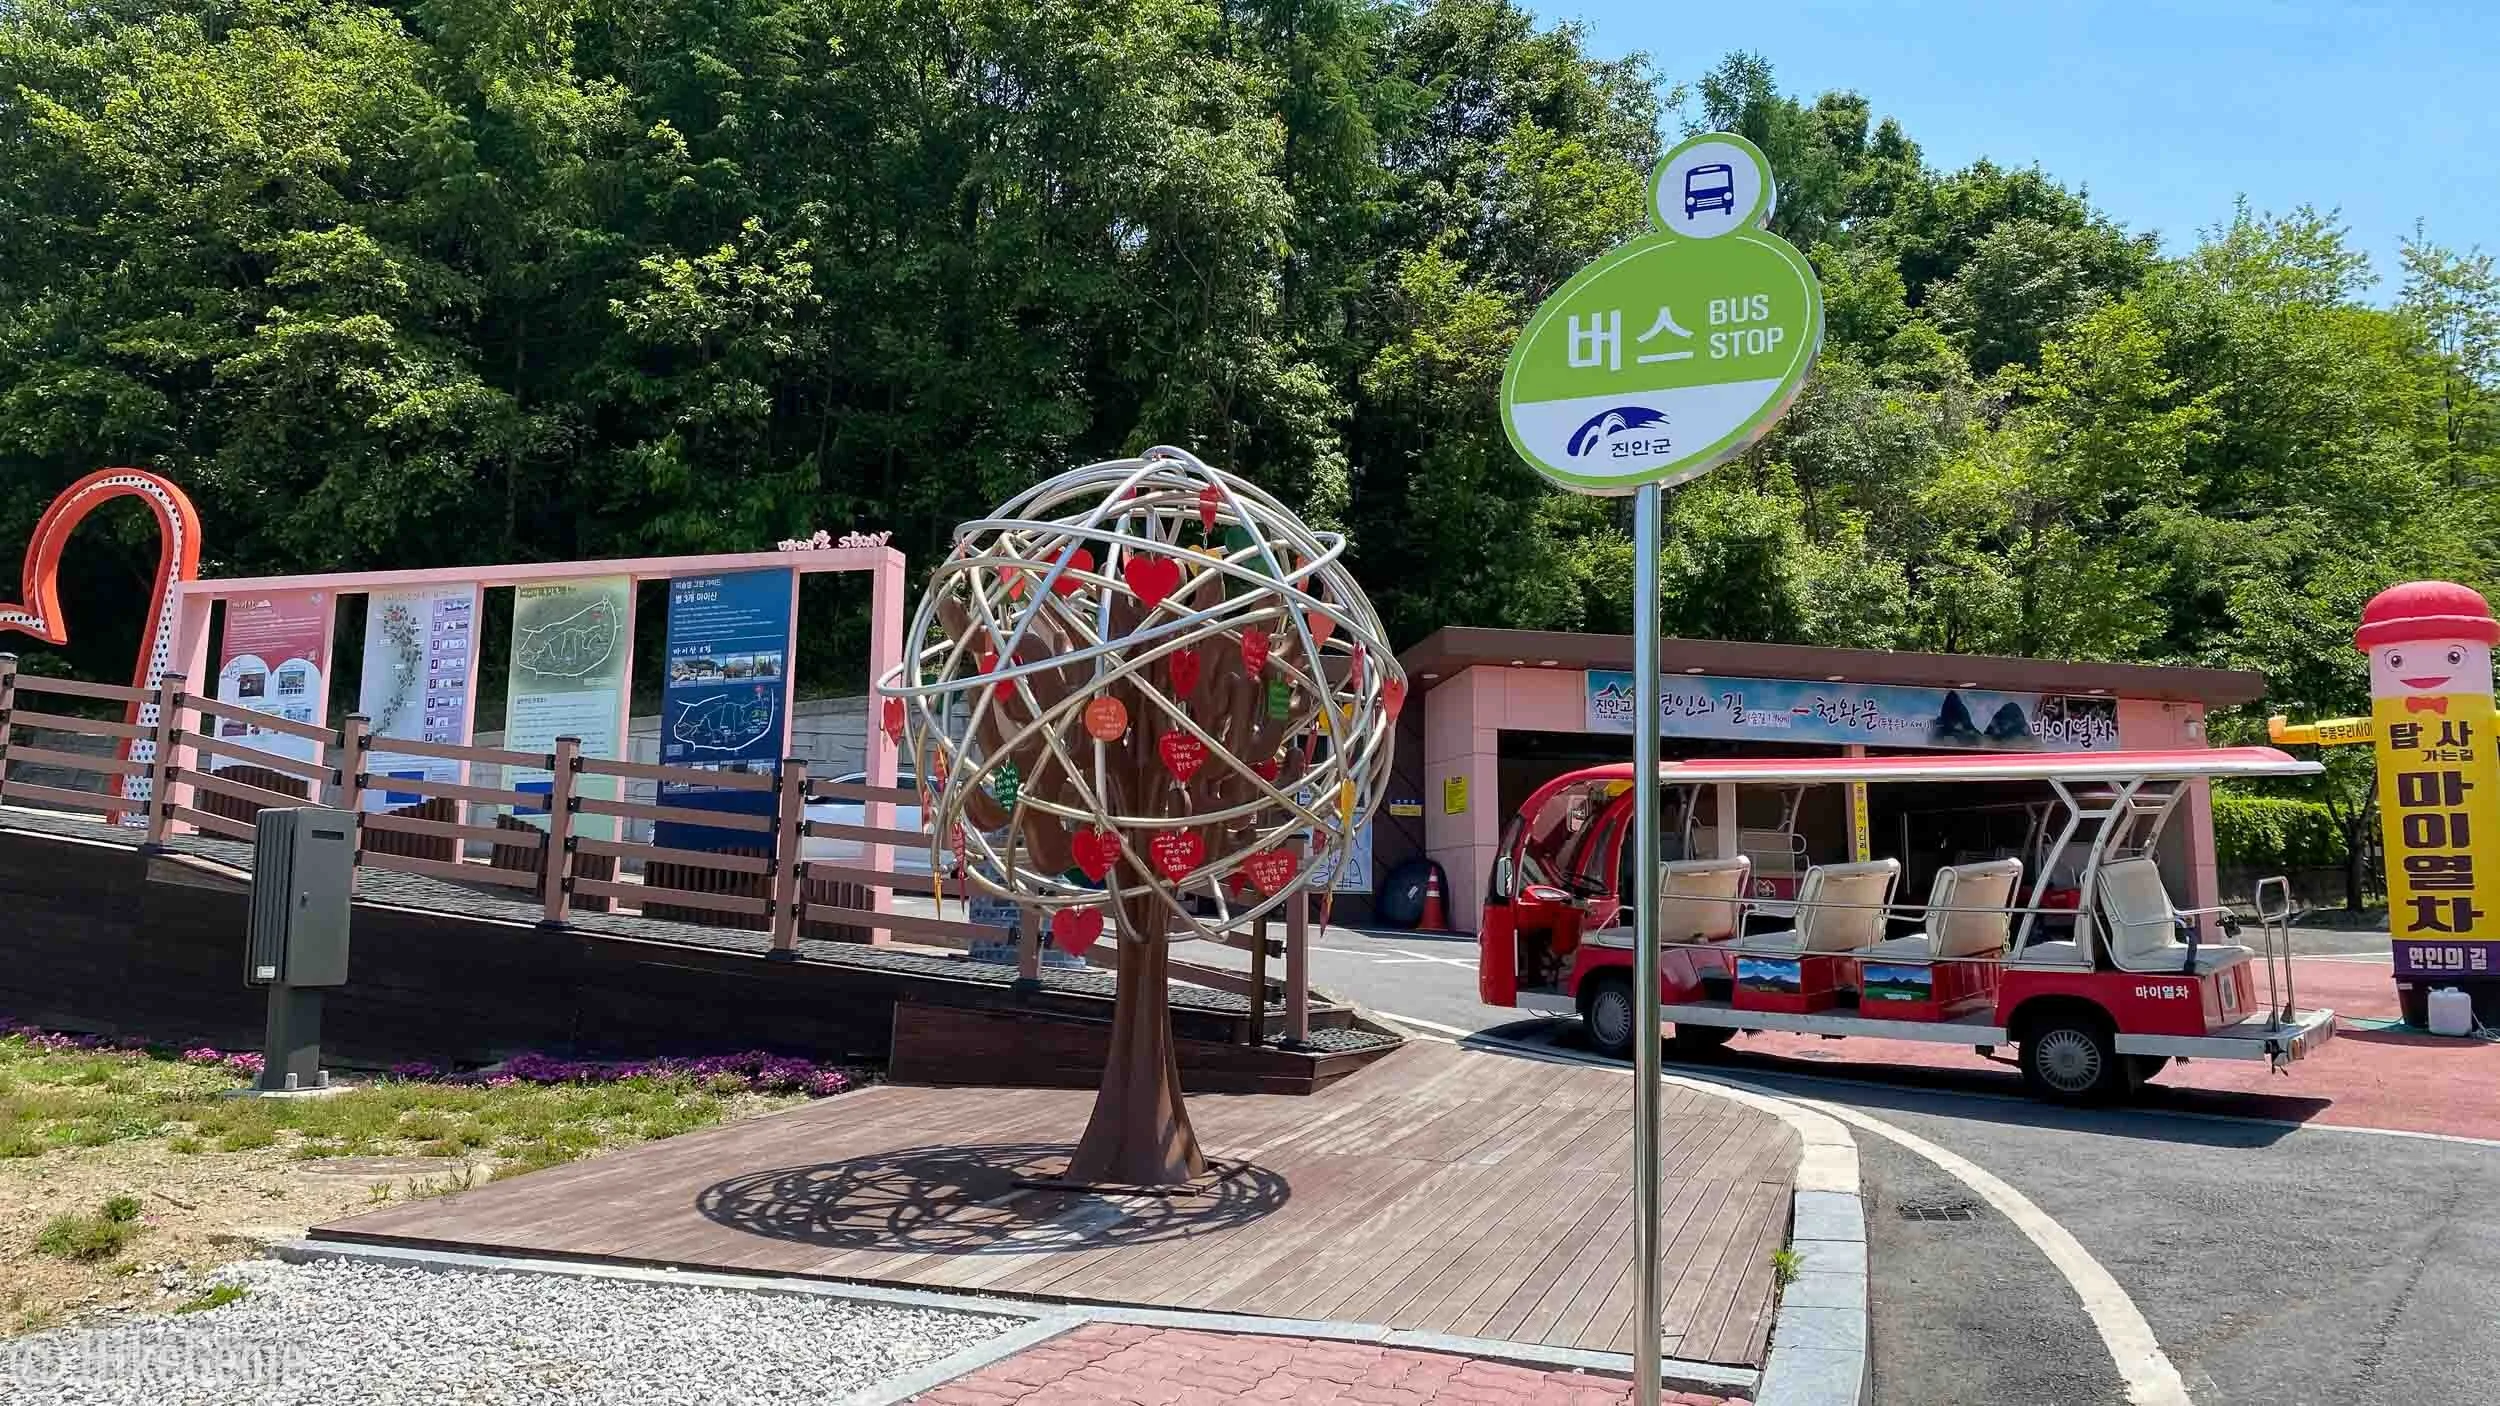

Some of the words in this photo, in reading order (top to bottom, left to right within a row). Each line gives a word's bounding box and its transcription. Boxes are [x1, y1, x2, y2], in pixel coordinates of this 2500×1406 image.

[1709, 294, 1769, 325] BUS
[1568, 306, 1694, 371] 버스
[1709, 327, 1785, 360] STOP
[1611, 438, 1672, 459] 진안군
[1596, 699, 1633, 714] 진안고
[1660, 694, 1716, 717] 연인의
[1723, 692, 1747, 724] 길
[1816, 696, 1878, 731] 천왕문
[2031, 714, 2115, 749] 마이열차
[2319, 721, 2373, 741] 두봉우리사이
[2422, 749, 2474, 762] 가는길
[2397, 771, 2485, 933] 마이열차
[2408, 946, 2464, 971] 연인의
[2469, 947, 2487, 971] 길
[2135, 984, 2190, 1000] 마이열차
